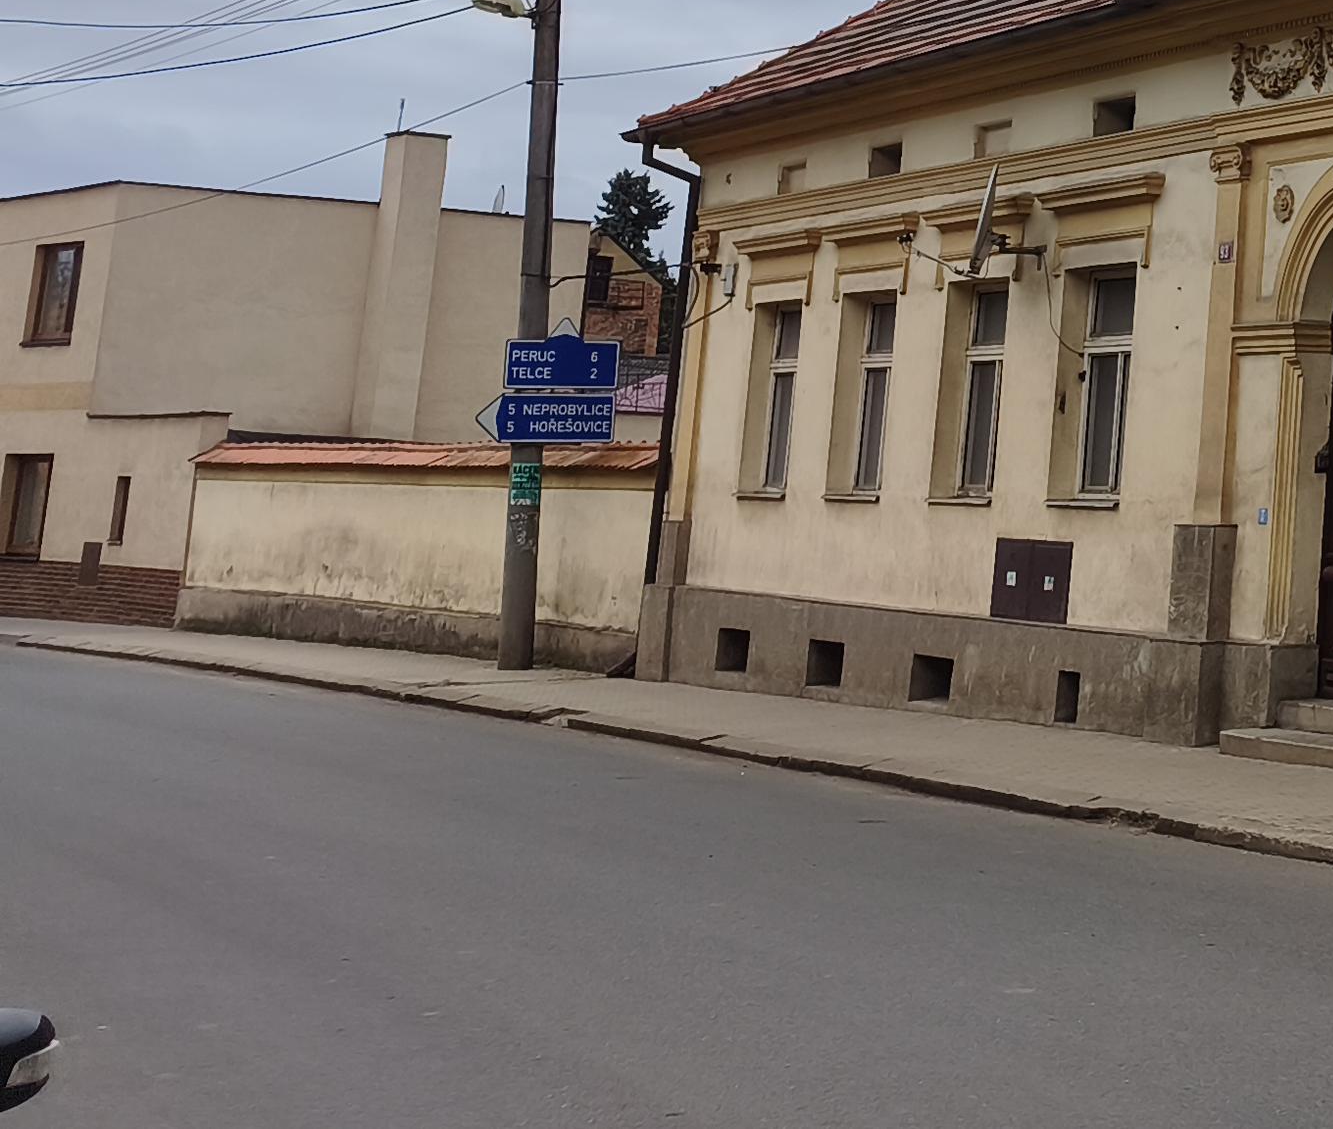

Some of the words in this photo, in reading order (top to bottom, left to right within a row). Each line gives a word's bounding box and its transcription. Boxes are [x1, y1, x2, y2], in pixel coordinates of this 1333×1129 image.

[511, 350, 556, 362] PERUC
[590, 351, 598, 362] 6
[511, 367, 552, 379] TELCE
[590, 368, 598, 379] 2
[508, 403, 516, 415] 5
[523, 404, 611, 416] NEPROBYLICE
[506, 421, 515, 433] 5
[530, 418, 610, 433] HOŘEŠOVICE
